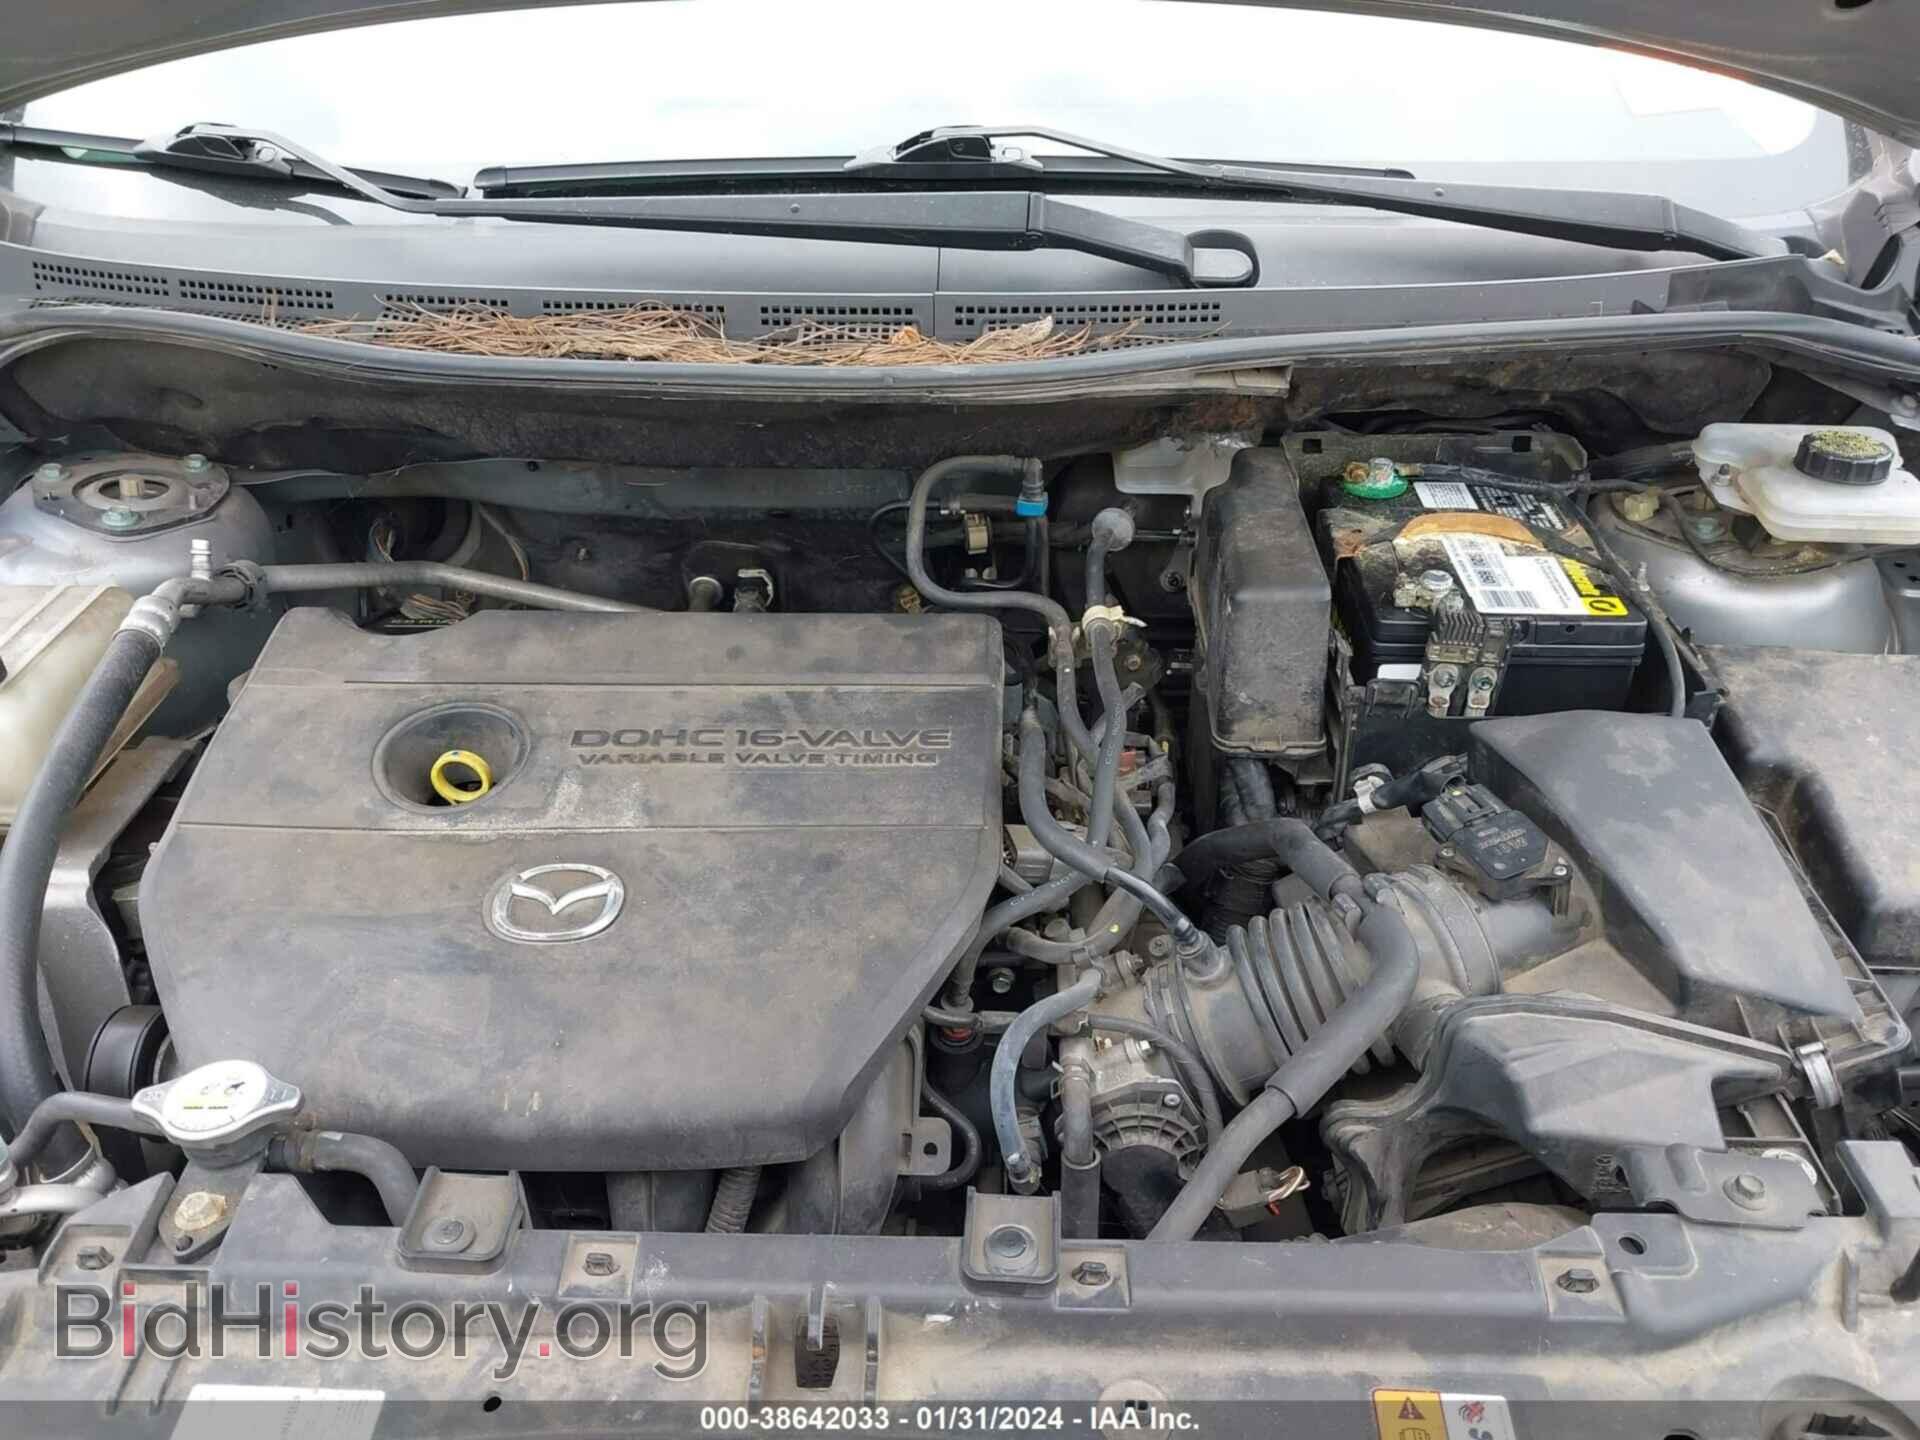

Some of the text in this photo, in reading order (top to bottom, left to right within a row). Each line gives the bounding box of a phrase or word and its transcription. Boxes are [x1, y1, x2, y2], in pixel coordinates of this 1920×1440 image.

[571, 728, 952, 748] DOHC 16-VALVE
[578, 752, 939, 766] VARIABLE VALVE TIMING
